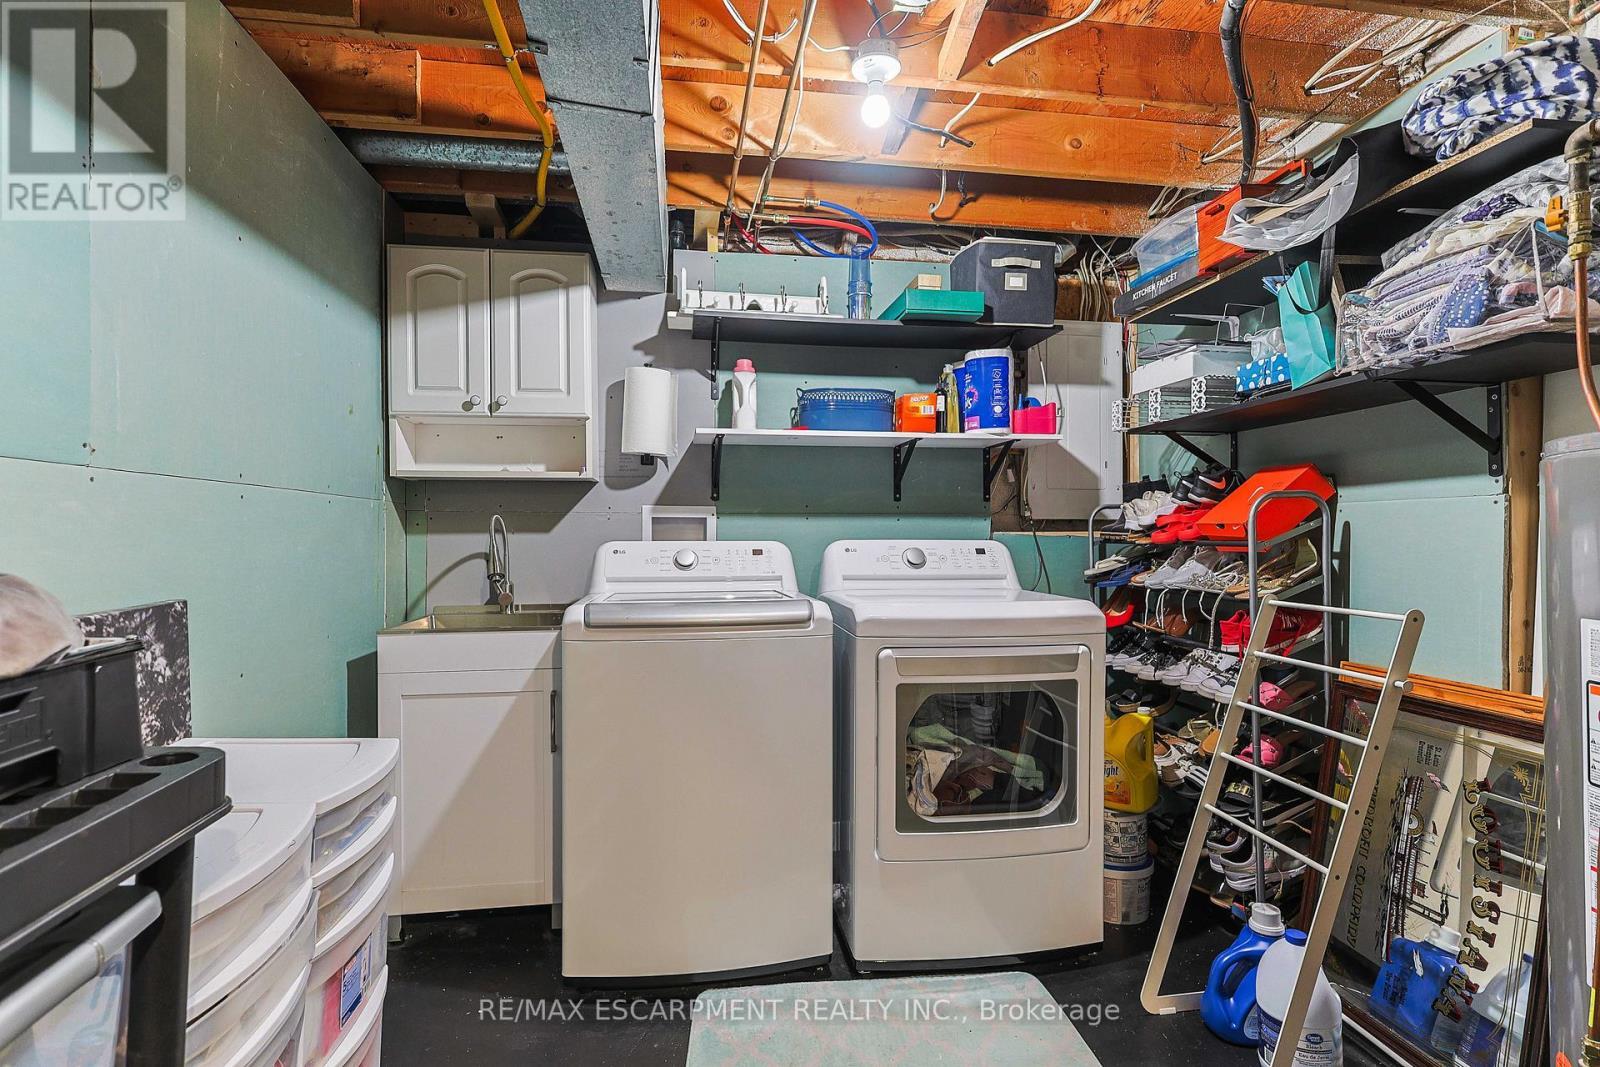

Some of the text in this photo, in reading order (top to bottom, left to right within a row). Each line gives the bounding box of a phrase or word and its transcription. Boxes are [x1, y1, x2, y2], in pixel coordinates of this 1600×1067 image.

[1132, 271, 1179, 301] KITCHEN FAUCET
[1432, 777, 1504, 1022] LOUISIANA
